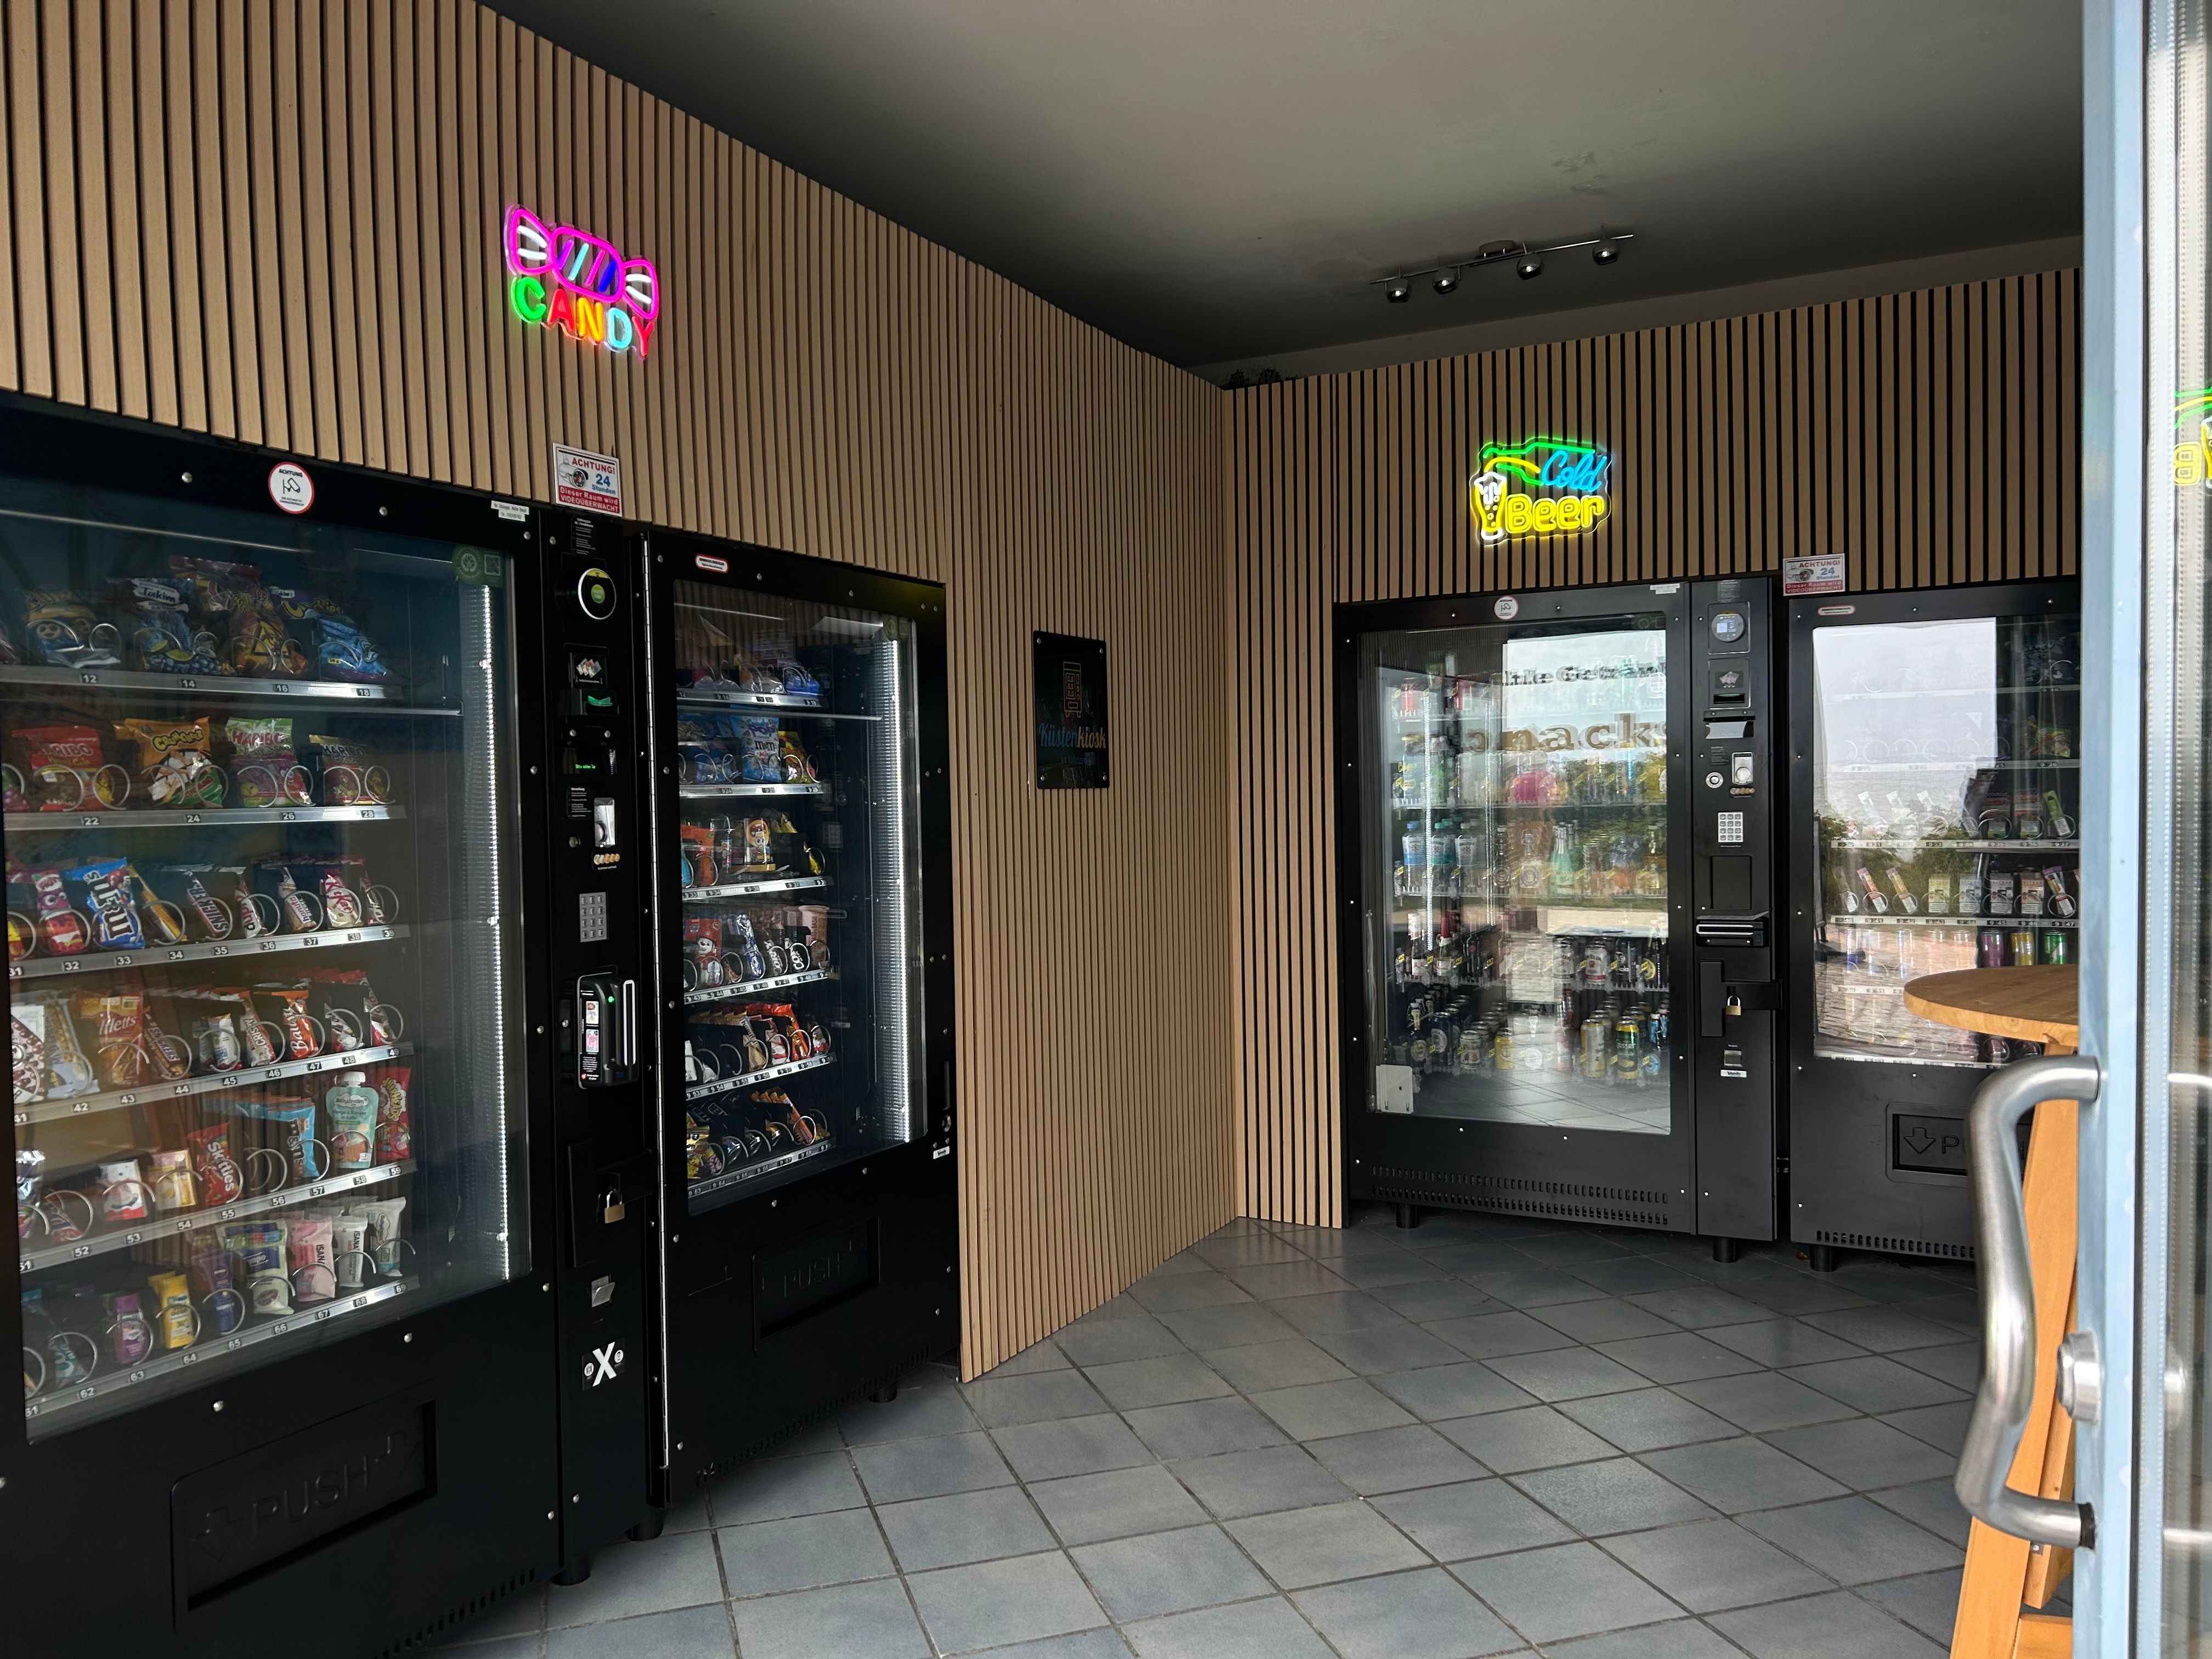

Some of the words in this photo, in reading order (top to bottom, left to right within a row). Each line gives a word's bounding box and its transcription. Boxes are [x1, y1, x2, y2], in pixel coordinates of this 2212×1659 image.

[515, 276, 655, 358] CANDY
[572, 457, 616, 475] ACHTUNG!
[278, 469, 303, 478] ACHTUNG
[1542, 450, 1607, 492] Cold
[596, 473, 611, 487] 24
[560, 486, 583, 497] Dieser
[584, 492, 603, 501] Raum
[592, 484, 616, 495] Stunden
[560, 494, 619, 512] VIDEOÜBERWACHT
[1505, 493, 1605, 534] Beer
[1799, 560, 1840, 568] ACHTUNG!
[1820, 567, 1835, 575] 24
[1787, 585, 1842, 594] VIDEOÜBERWACHT
[83, 675, 97, 683] 12
[182, 680, 195, 688] 14
[276, 685, 289, 693] 16
[1039, 722, 1106, 749] Küstenkiosk
[321, 744, 366, 757] HARIBO
[187, 815, 201, 823] 24
[289, 895, 312, 924] hanuta
[169, 951, 183, 959] 34
[65, 962, 80, 970] 32
[9, 967, 22, 976] 31
[223, 1077, 236, 1085] 45
[121, 1095, 134, 1103] 43
[74, 1103, 88, 1111] 42
[14, 1114, 27, 1122] 41
[391, 1167, 401, 1175] 59
[312, 1187, 325, 1195] 57
[273, 1197, 285, 1205] 56
[222, 1209, 235, 1218] 55
[178, 1220, 191, 1229] 54
[126, 1234, 141, 1243] 53
[75, 1246, 89, 1256] 52
[396, 1284, 406, 1293] 69
[318, 1310, 330, 1318] 67
[274, 1324, 286, 1332] 66
[228, 1339, 240, 1348] 65
[183, 1353, 196, 1364] 64
[130, 1372, 144, 1381] 63
[80, 1387, 95, 1398] 62
[253, 1455, 368, 1538] PUSH
